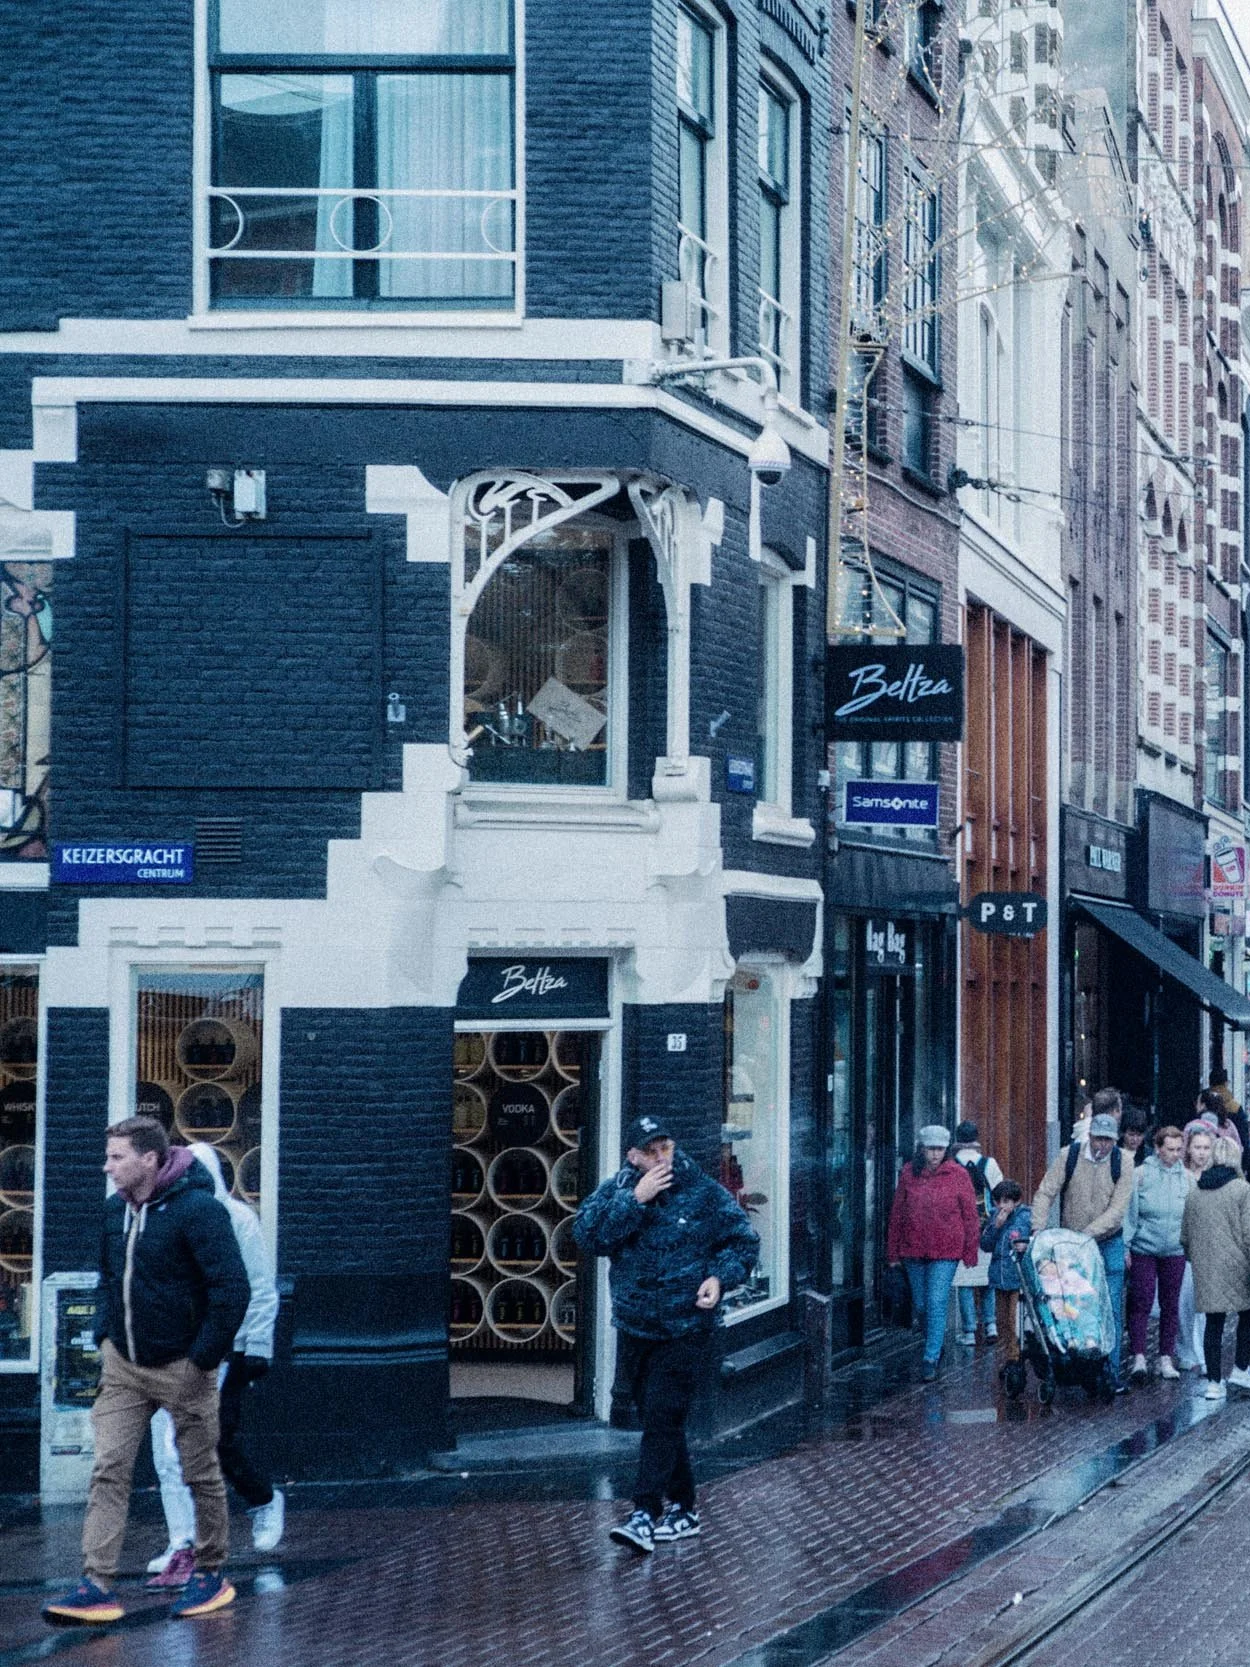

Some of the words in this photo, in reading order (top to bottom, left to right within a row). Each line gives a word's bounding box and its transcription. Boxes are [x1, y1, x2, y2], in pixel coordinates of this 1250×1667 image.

[834, 664, 953, 716] Beltza
[852, 796, 928, 811] Samsonite
[62, 849, 184, 864] KEIZERSGRACHT
[137, 869, 184, 879] CENTRUM
[981, 902, 996, 923] P
[1003, 904, 1015, 921] &
[1022, 902, 1037, 923] T
[491, 965, 568, 1003] Beltza
[670, 1036, 683, 1049] 35
[502, 1104, 535, 1114] VODKA
